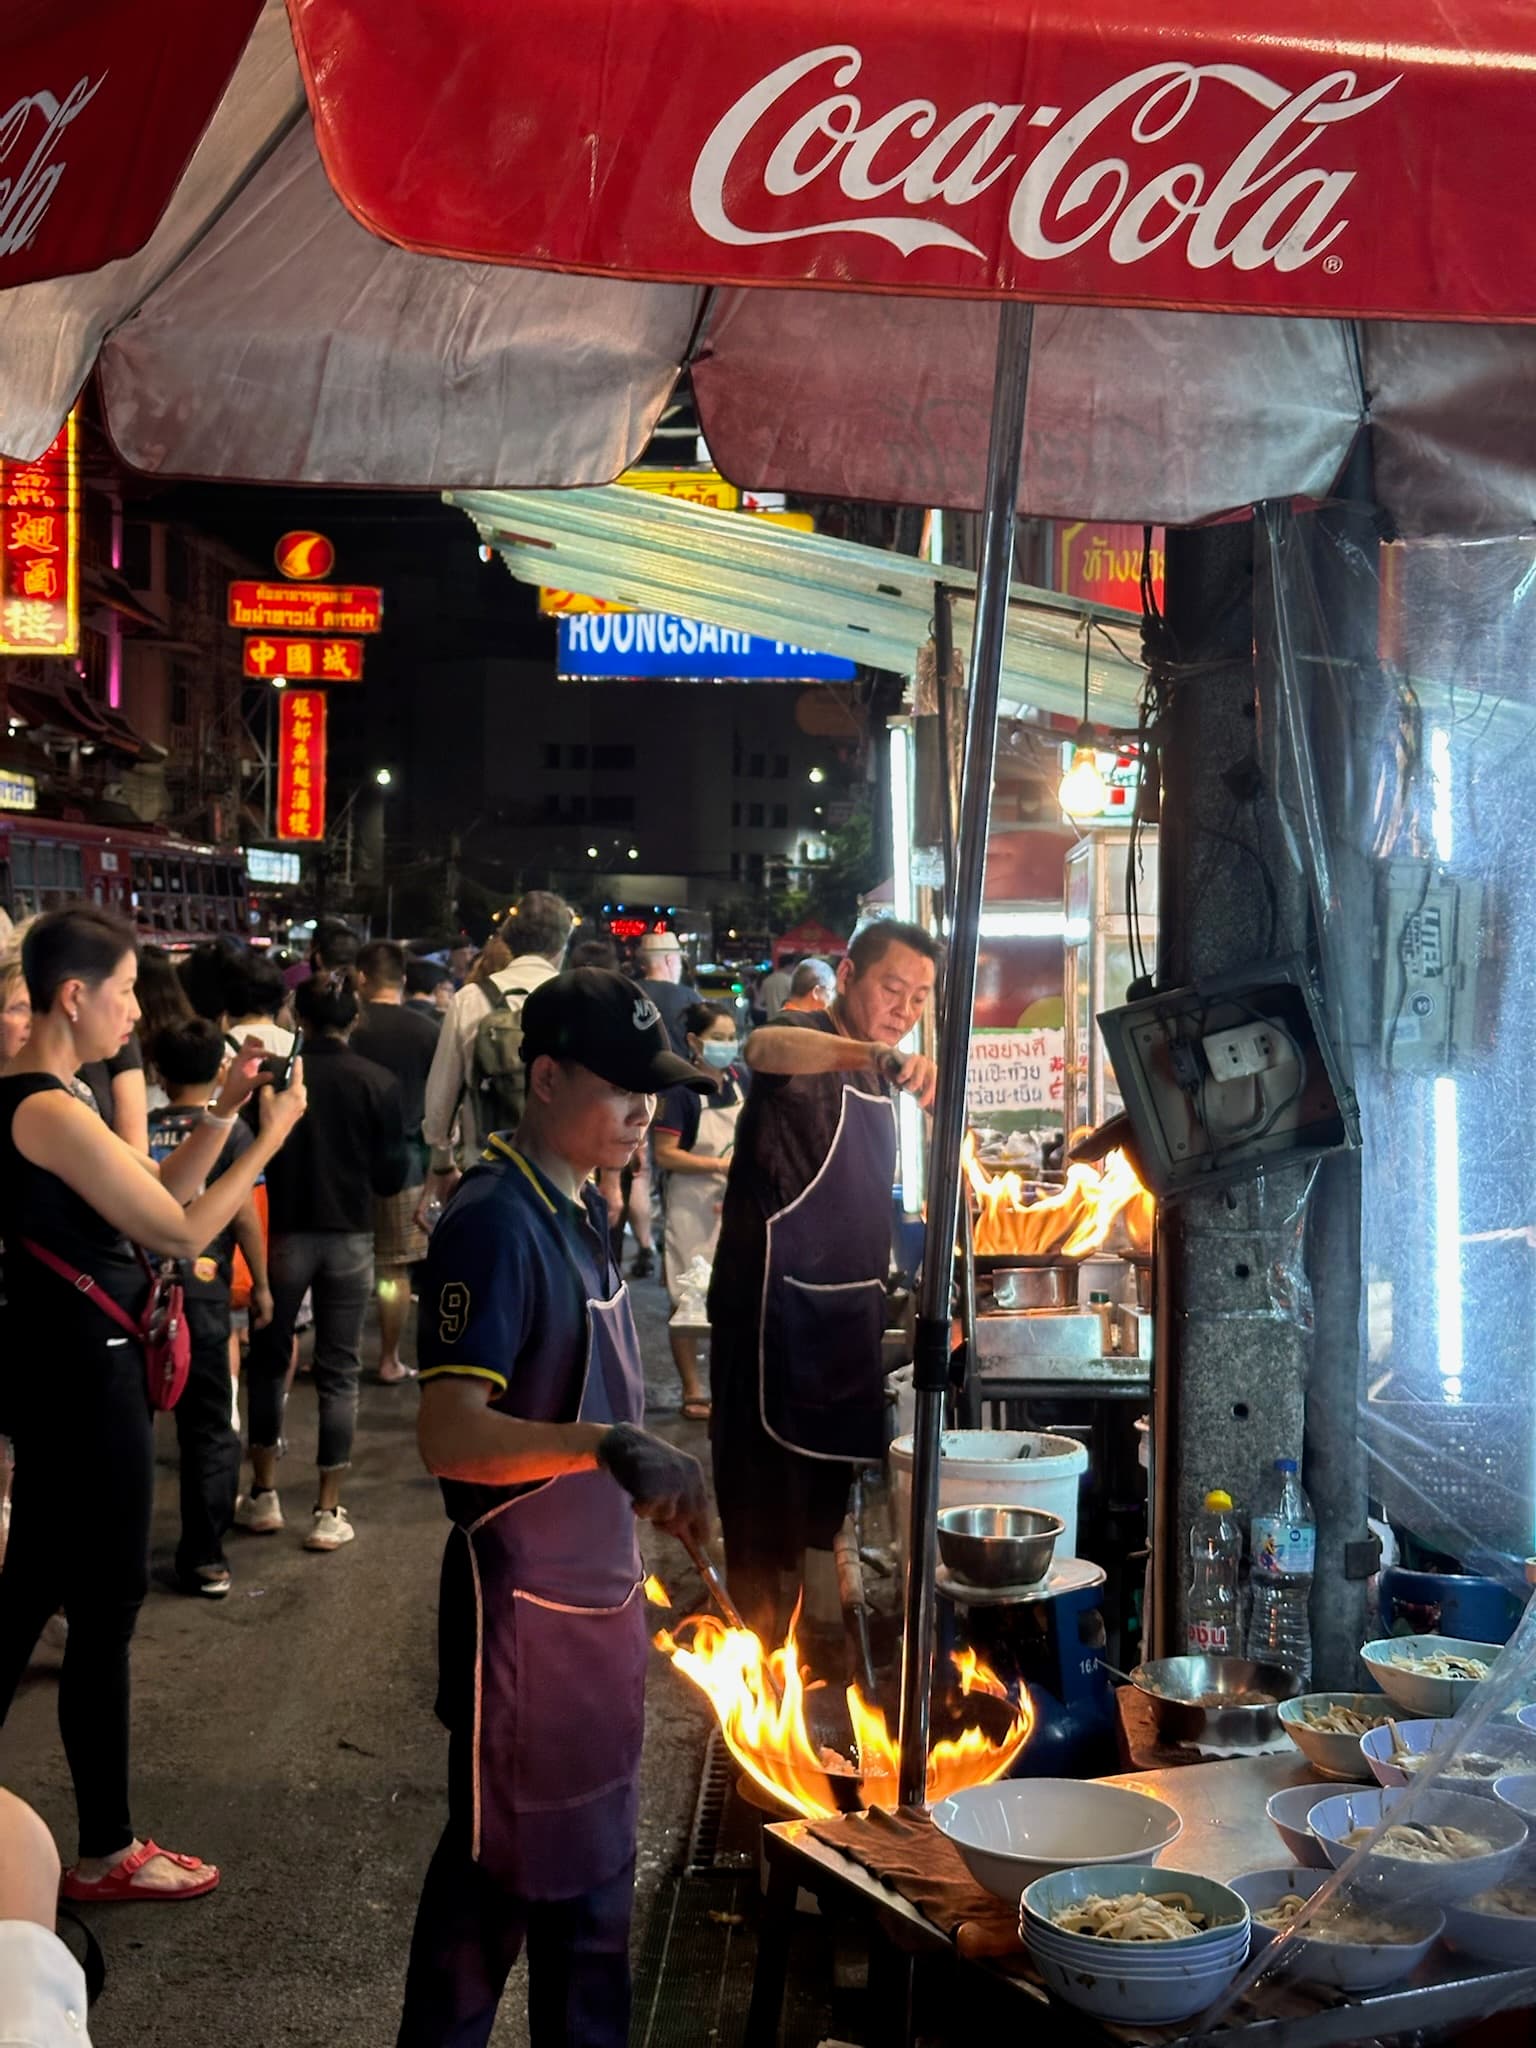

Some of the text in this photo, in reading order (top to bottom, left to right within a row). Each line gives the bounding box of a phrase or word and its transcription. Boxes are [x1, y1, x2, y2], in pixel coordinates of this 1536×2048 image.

[689, 44, 1404, 273] Coca-Cola
[249, 639, 352, 677] 中國城
[439, 1281, 470, 1344] 9
